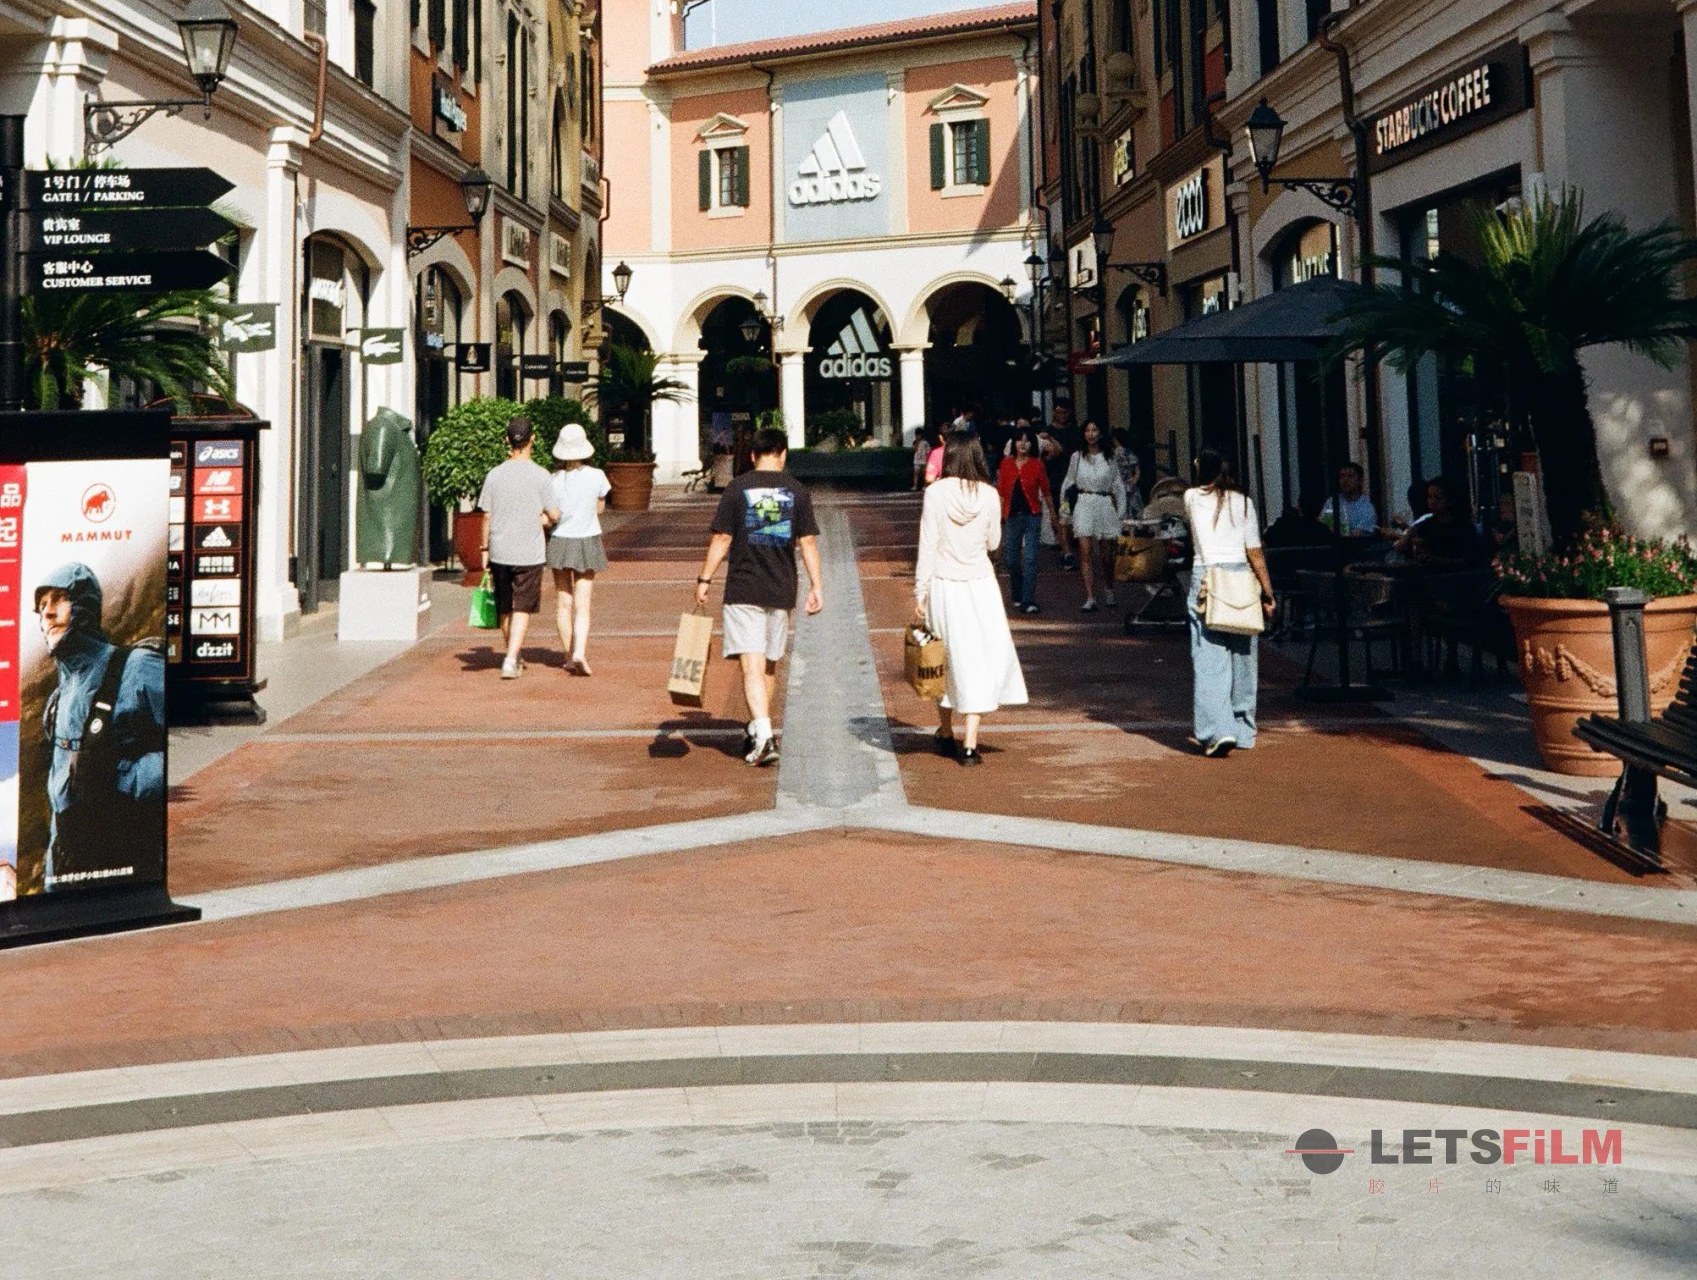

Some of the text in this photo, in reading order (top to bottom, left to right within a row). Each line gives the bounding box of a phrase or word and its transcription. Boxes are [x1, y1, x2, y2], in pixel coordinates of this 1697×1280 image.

[1376, 64, 1490, 155] STARBUCKS COFFEE
[788, 169, 882, 206] adidas
[42, 193, 73, 202] GATE
[94, 191, 145, 201] PARKING
[43, 233, 111, 244] VIP LOUNGE
[43, 261, 94, 275] 客服中心
[42, 275, 152, 288] CUSTOMER SERVICE
[820, 354, 892, 378] adidas
[61, 530, 132, 542] MAMMUT
[918, 664, 944, 679] NIKE
